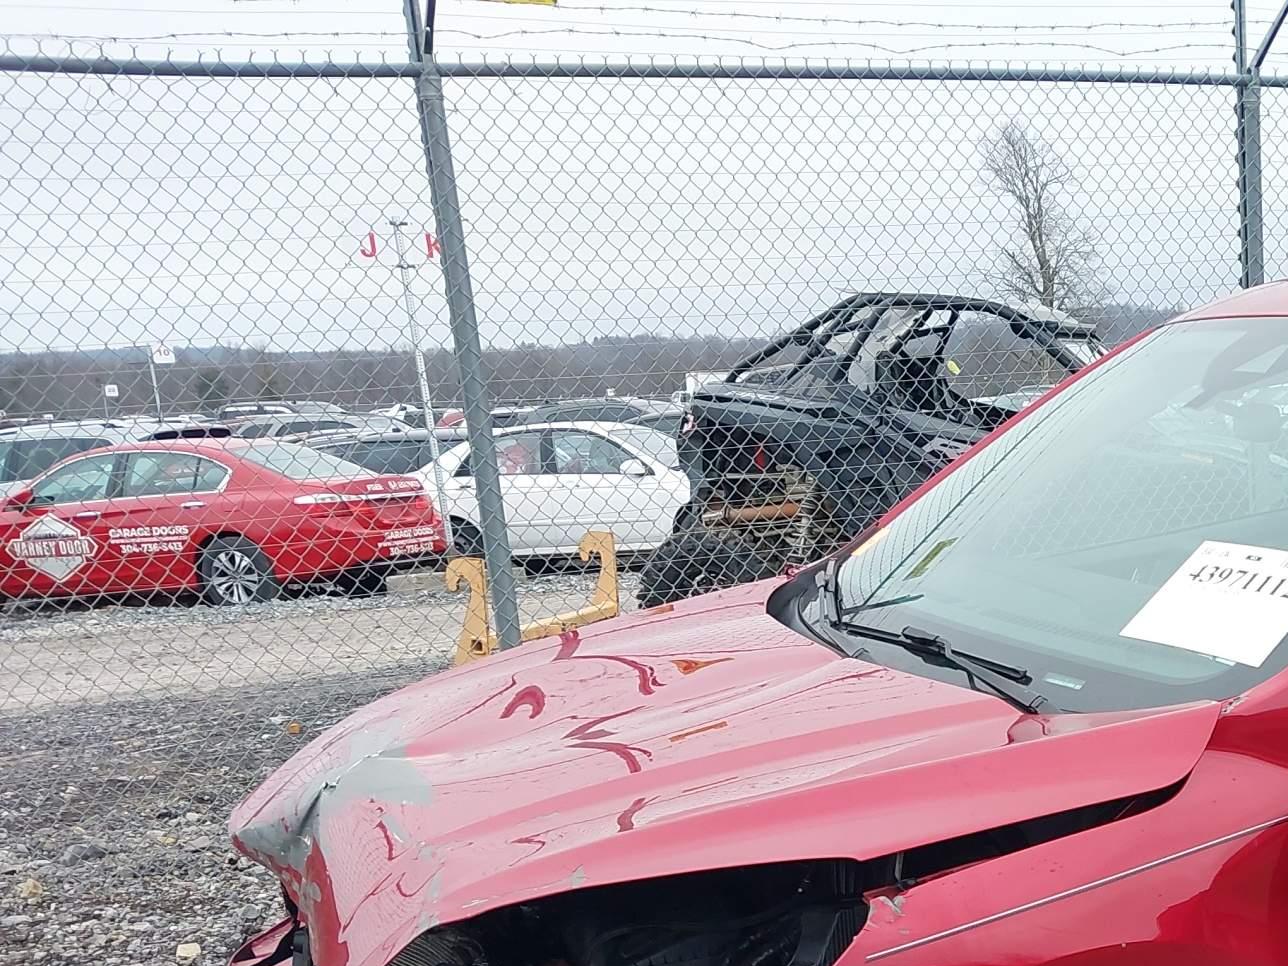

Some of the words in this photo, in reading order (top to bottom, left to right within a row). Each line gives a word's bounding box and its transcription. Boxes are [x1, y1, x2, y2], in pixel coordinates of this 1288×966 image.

[360, 231, 377, 257] J
[108, 527, 150, 538] GARAGE
[152, 525, 189, 536] DOORS
[13, 541, 56, 557] VARNEY
[59, 540, 90, 555] DOOR
